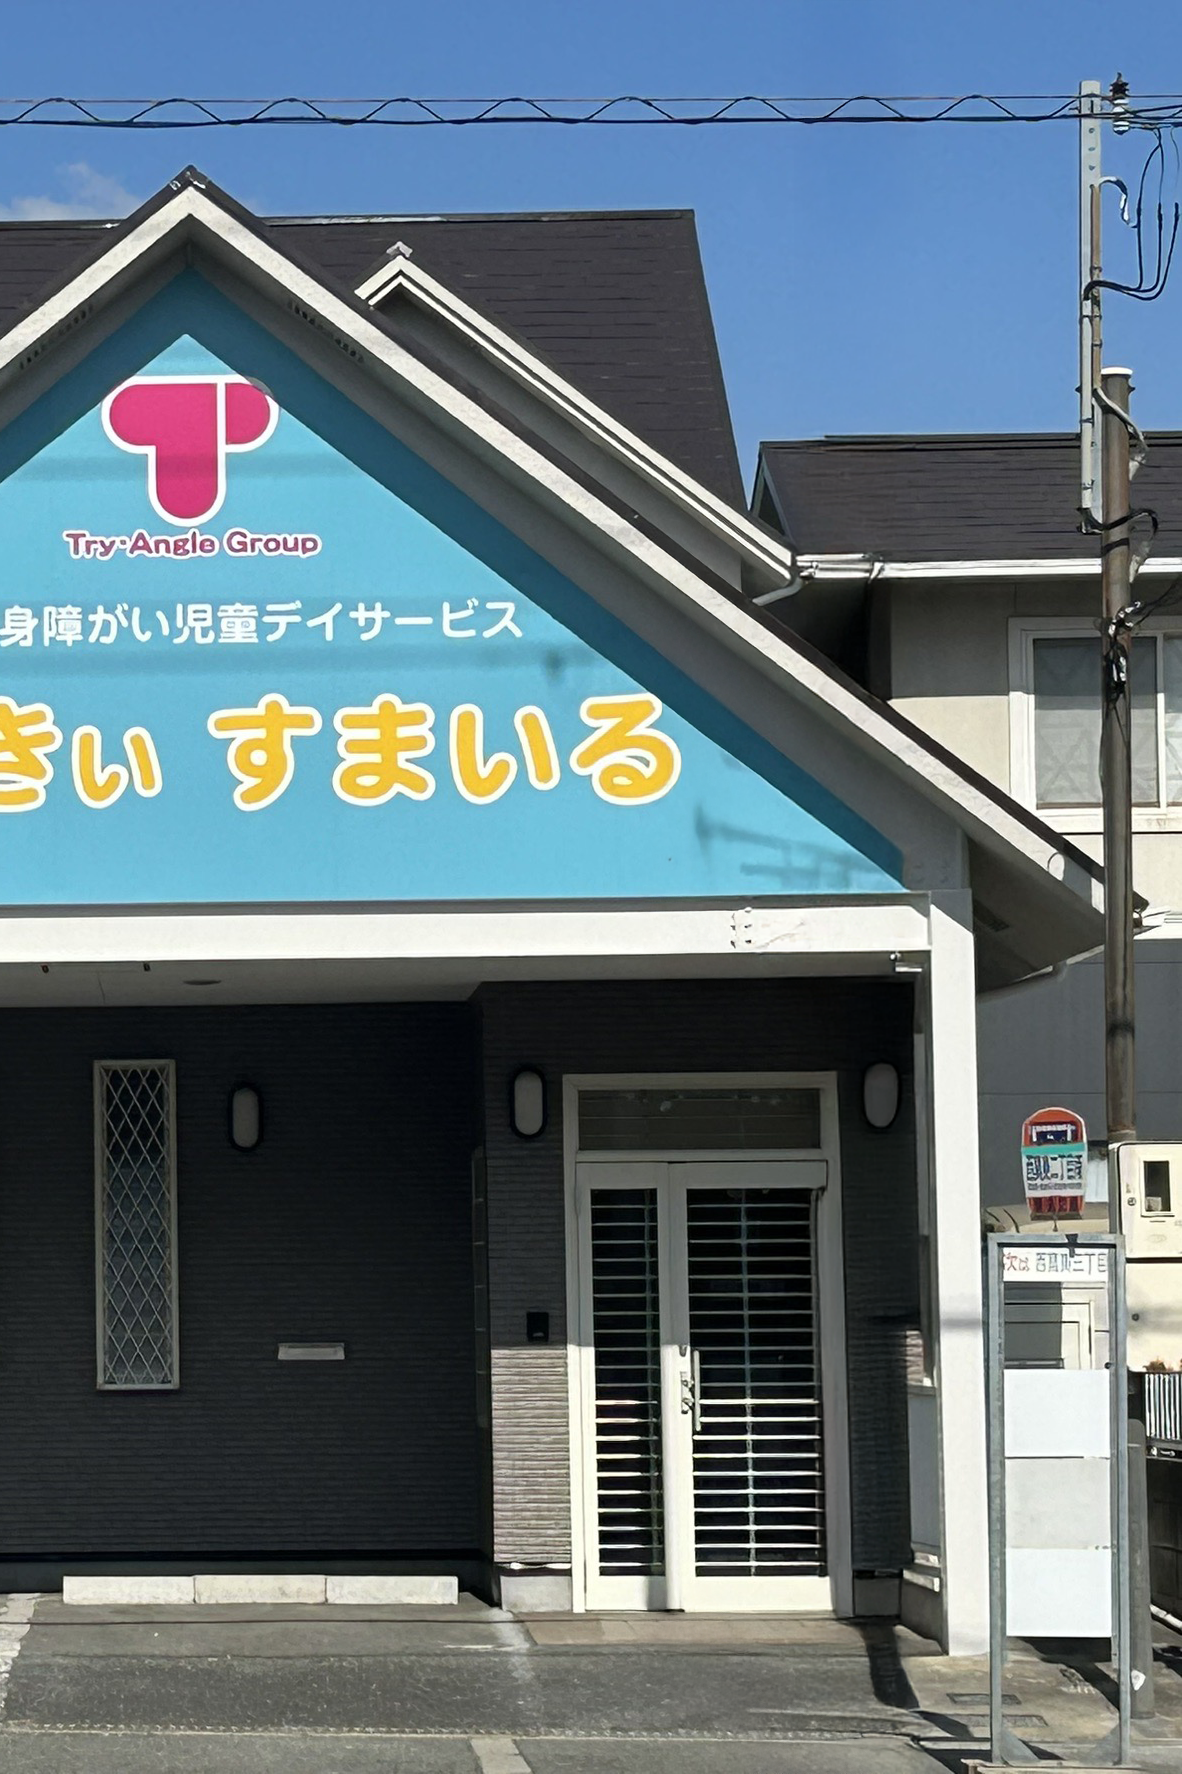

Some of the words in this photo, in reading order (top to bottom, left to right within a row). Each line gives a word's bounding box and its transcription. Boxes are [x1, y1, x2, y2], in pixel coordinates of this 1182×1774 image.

[225, 529, 320, 557] Group
[208, 694, 681, 812] すまいる
